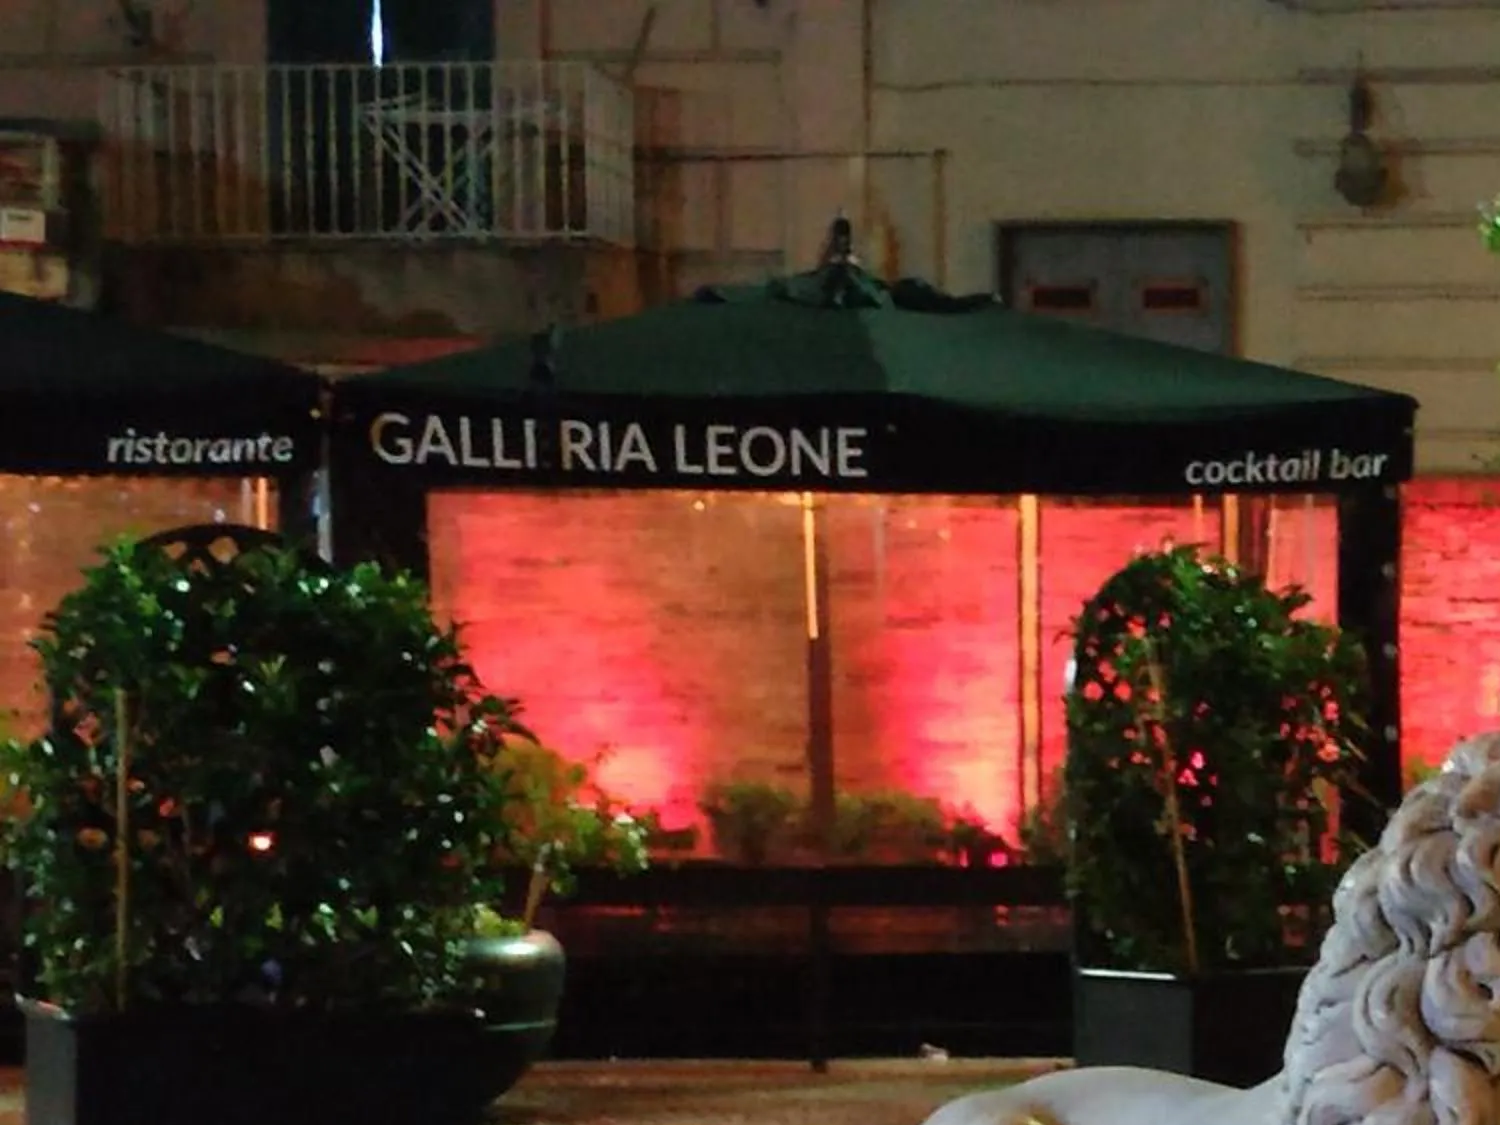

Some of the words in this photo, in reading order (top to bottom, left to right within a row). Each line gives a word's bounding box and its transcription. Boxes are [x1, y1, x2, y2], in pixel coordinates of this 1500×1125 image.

[107, 428, 294, 464] ristorante
[674, 424, 869, 477] LEONE
[1185, 449, 1321, 485] cocktail
[1329, 448, 1388, 481] bar
